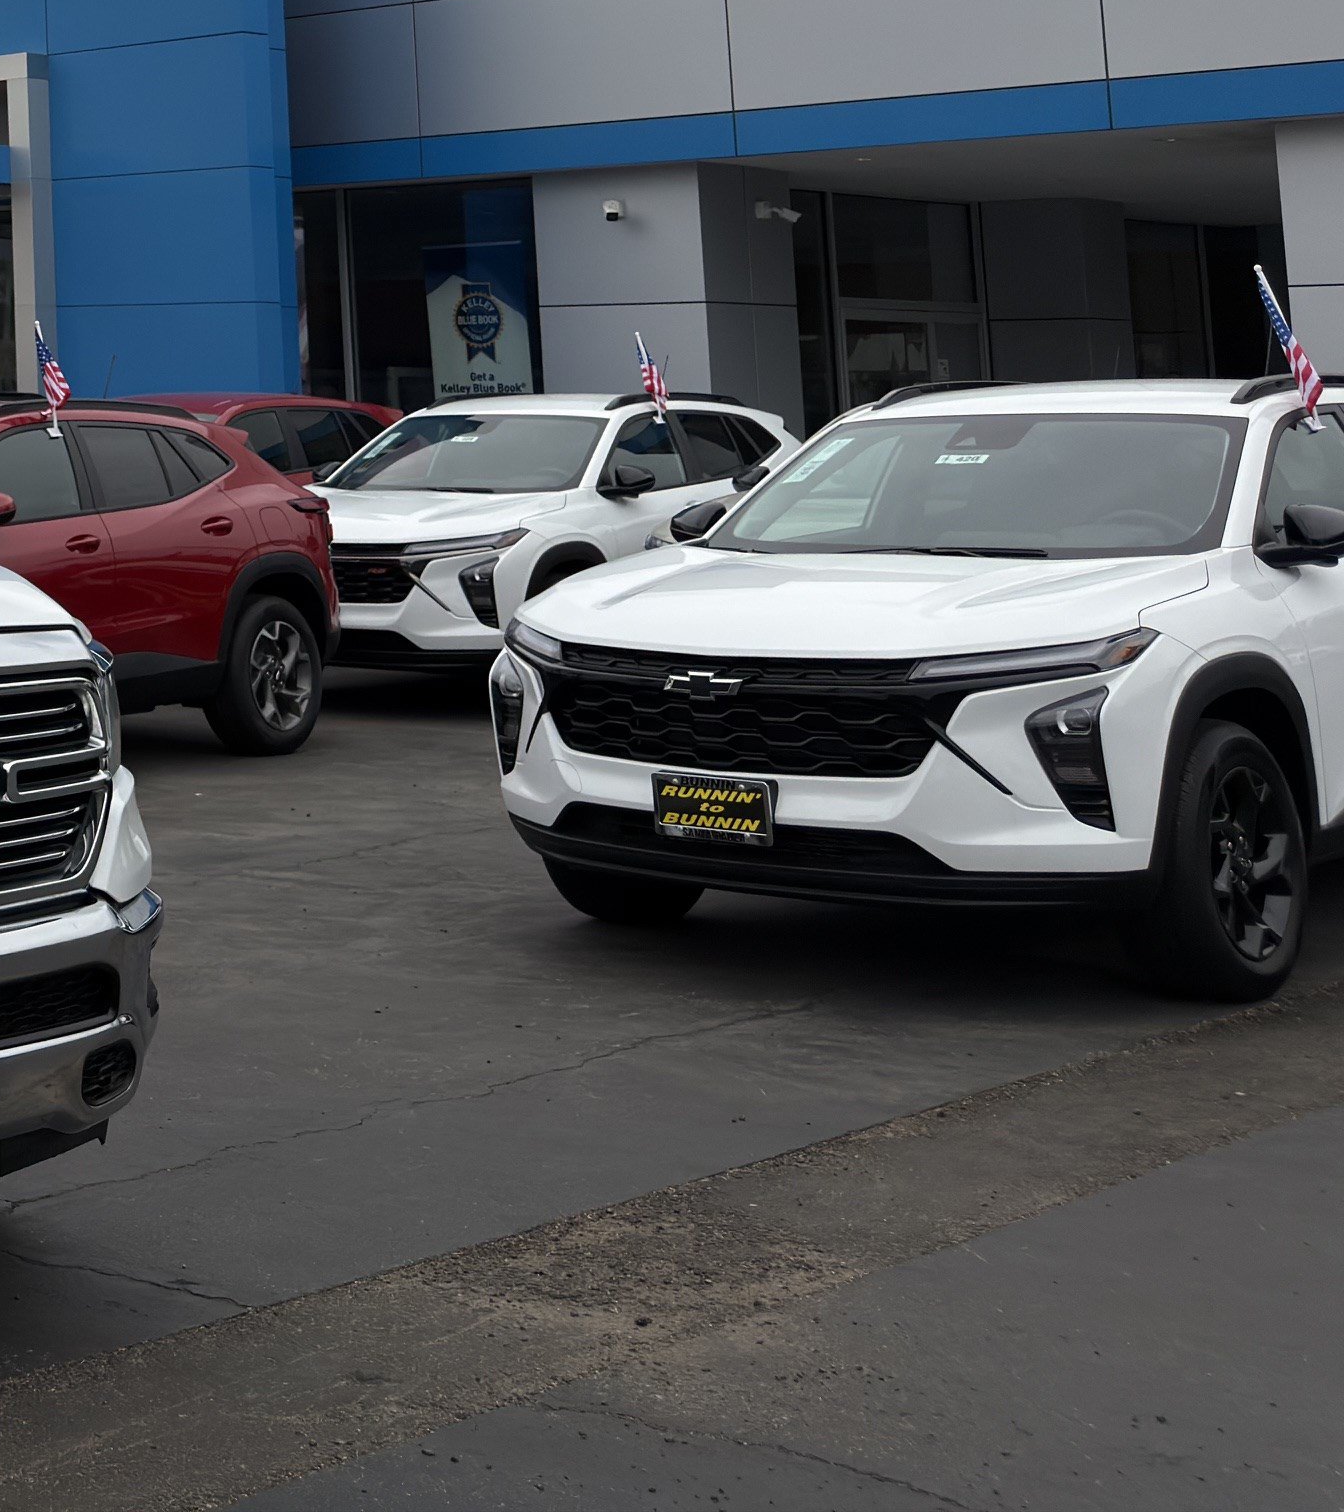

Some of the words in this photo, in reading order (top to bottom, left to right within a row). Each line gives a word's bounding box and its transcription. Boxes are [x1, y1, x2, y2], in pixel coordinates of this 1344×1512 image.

[461, 297, 496, 314] KELLEY
[457, 315, 478, 326] BLUE
[478, 314, 499, 325] BOOK
[470, 372, 487, 382] Get
[488, 373, 495, 382] a
[440, 383, 471, 395] Kelley
[473, 383, 495, 393] Blue
[661, 785, 762, 804] RUNNIN'
[699, 802, 725, 813] to
[662, 812, 761, 832] BUNNIN
